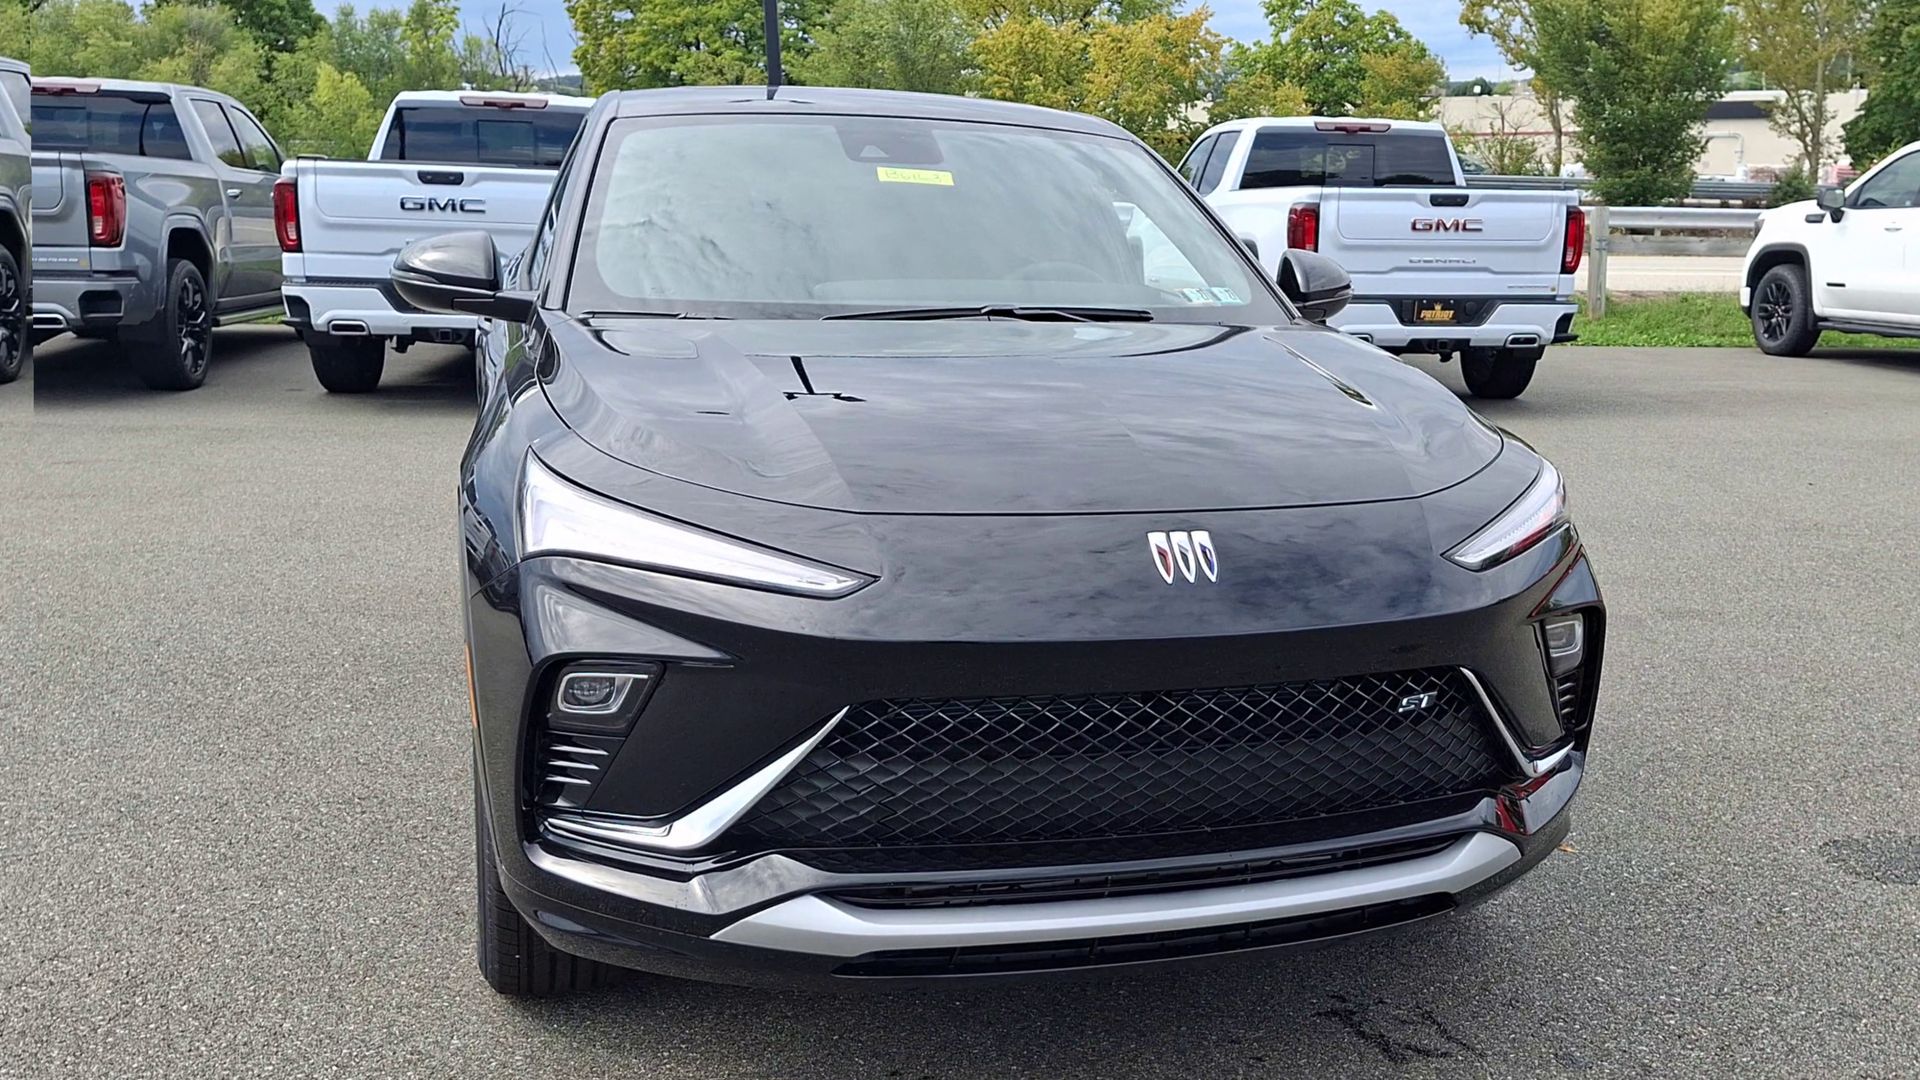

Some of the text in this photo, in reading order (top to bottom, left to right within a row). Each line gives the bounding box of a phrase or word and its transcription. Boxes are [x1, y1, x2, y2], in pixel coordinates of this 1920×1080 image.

[400, 196, 486, 214] GMC
[1411, 218, 1483, 232] GMC
[1398, 691, 1438, 712] ST
